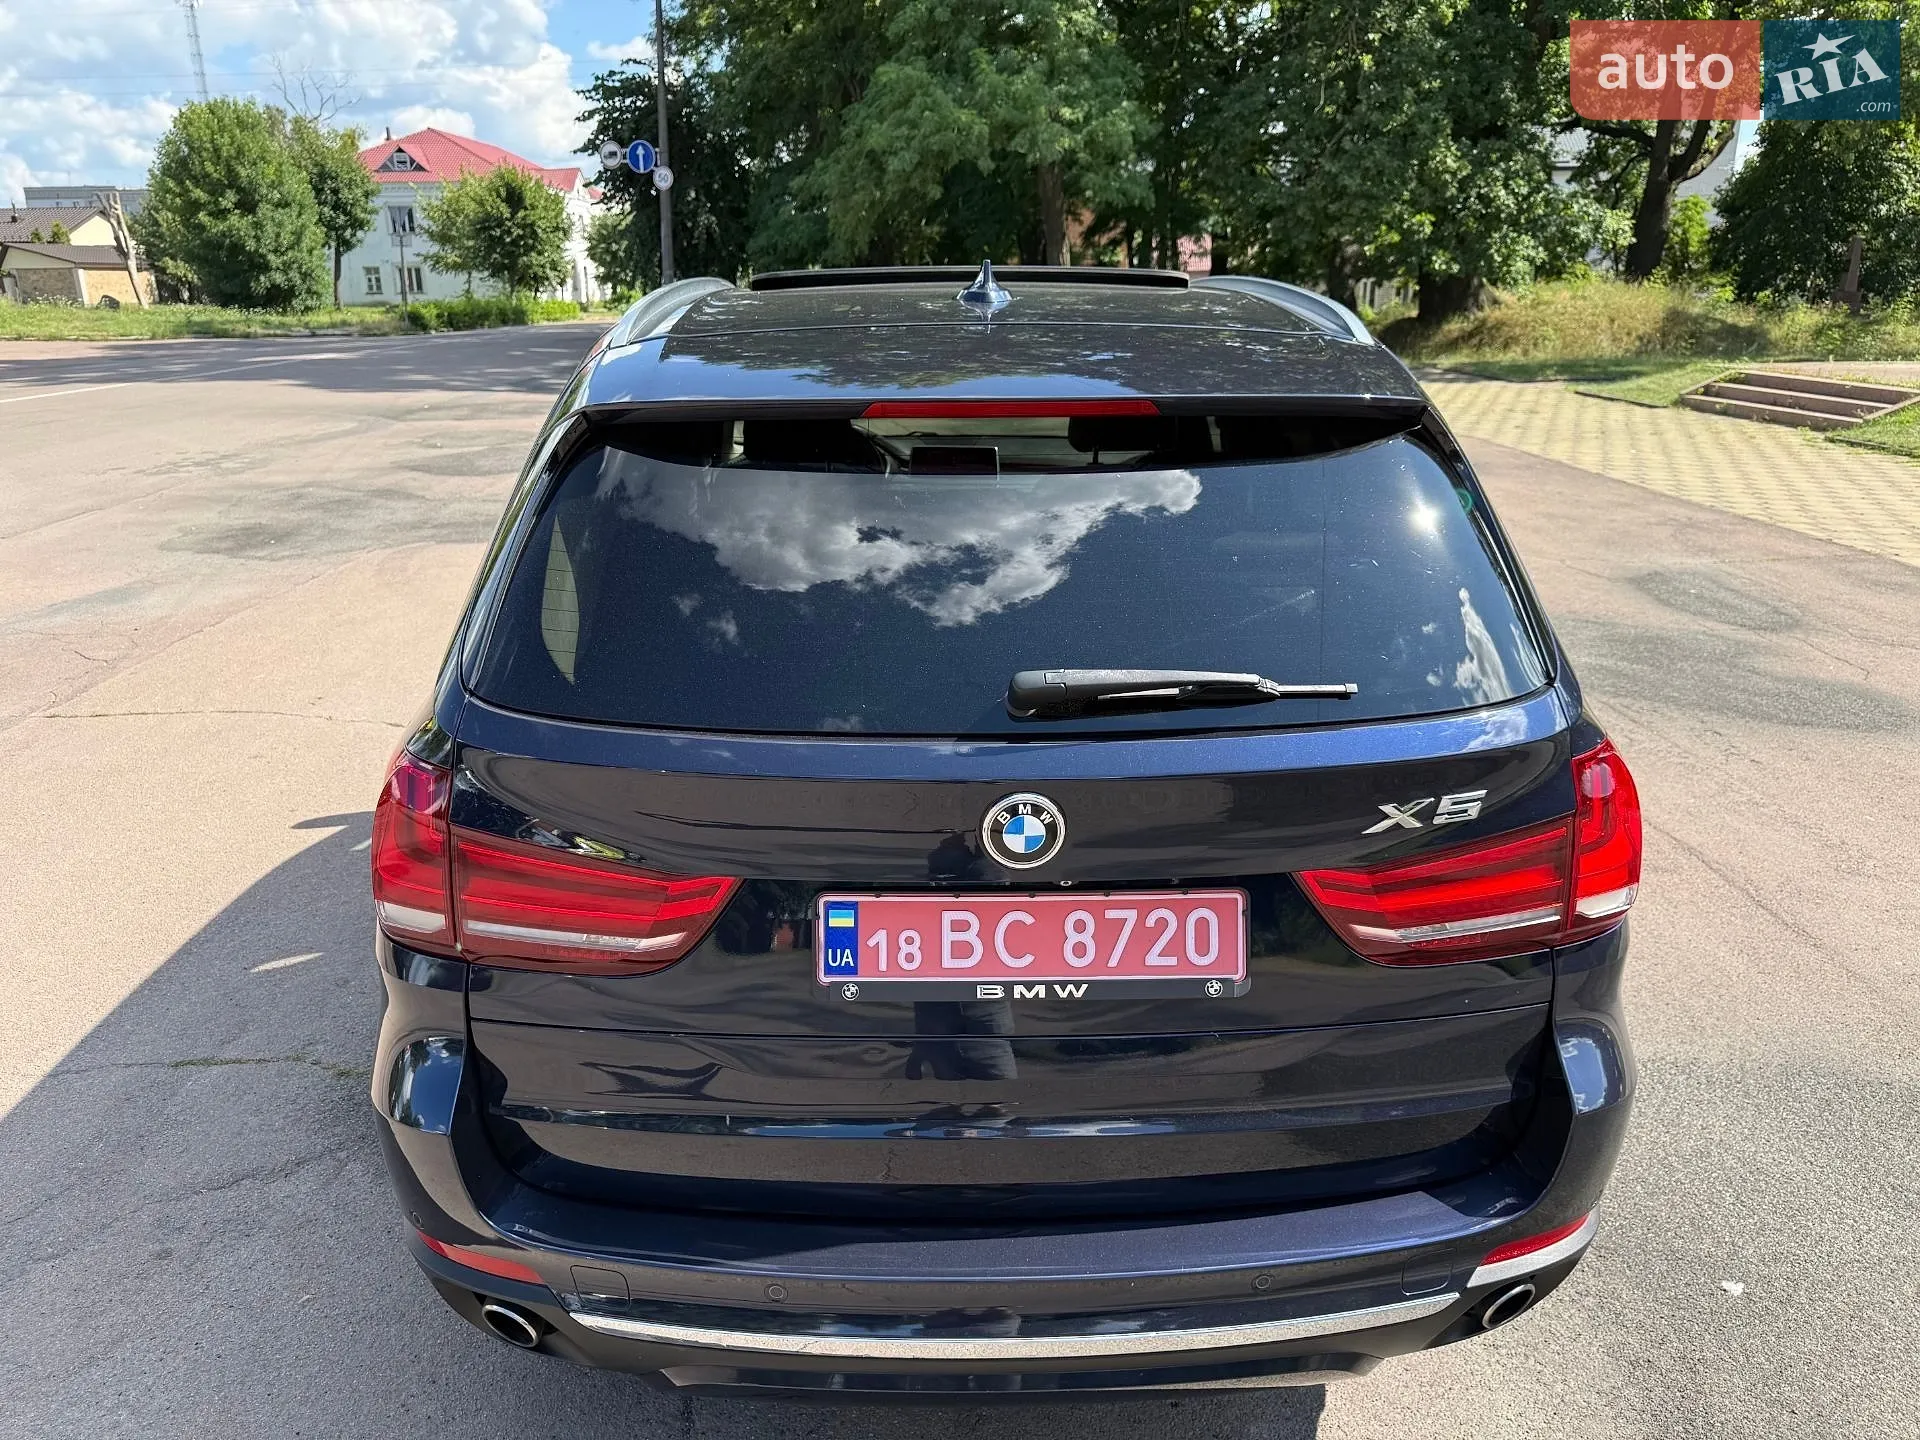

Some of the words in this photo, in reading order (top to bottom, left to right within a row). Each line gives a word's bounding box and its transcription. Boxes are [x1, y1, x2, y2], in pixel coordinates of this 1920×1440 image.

[996, 803, 1054, 825] BMW
[1361, 790, 1488, 834] X5
[866, 929, 922, 972] 18
[941, 910, 1036, 969] BC
[1063, 907, 1220, 968] 8720
[828, 948, 855, 967] UA
[976, 983, 1089, 999] BMW
